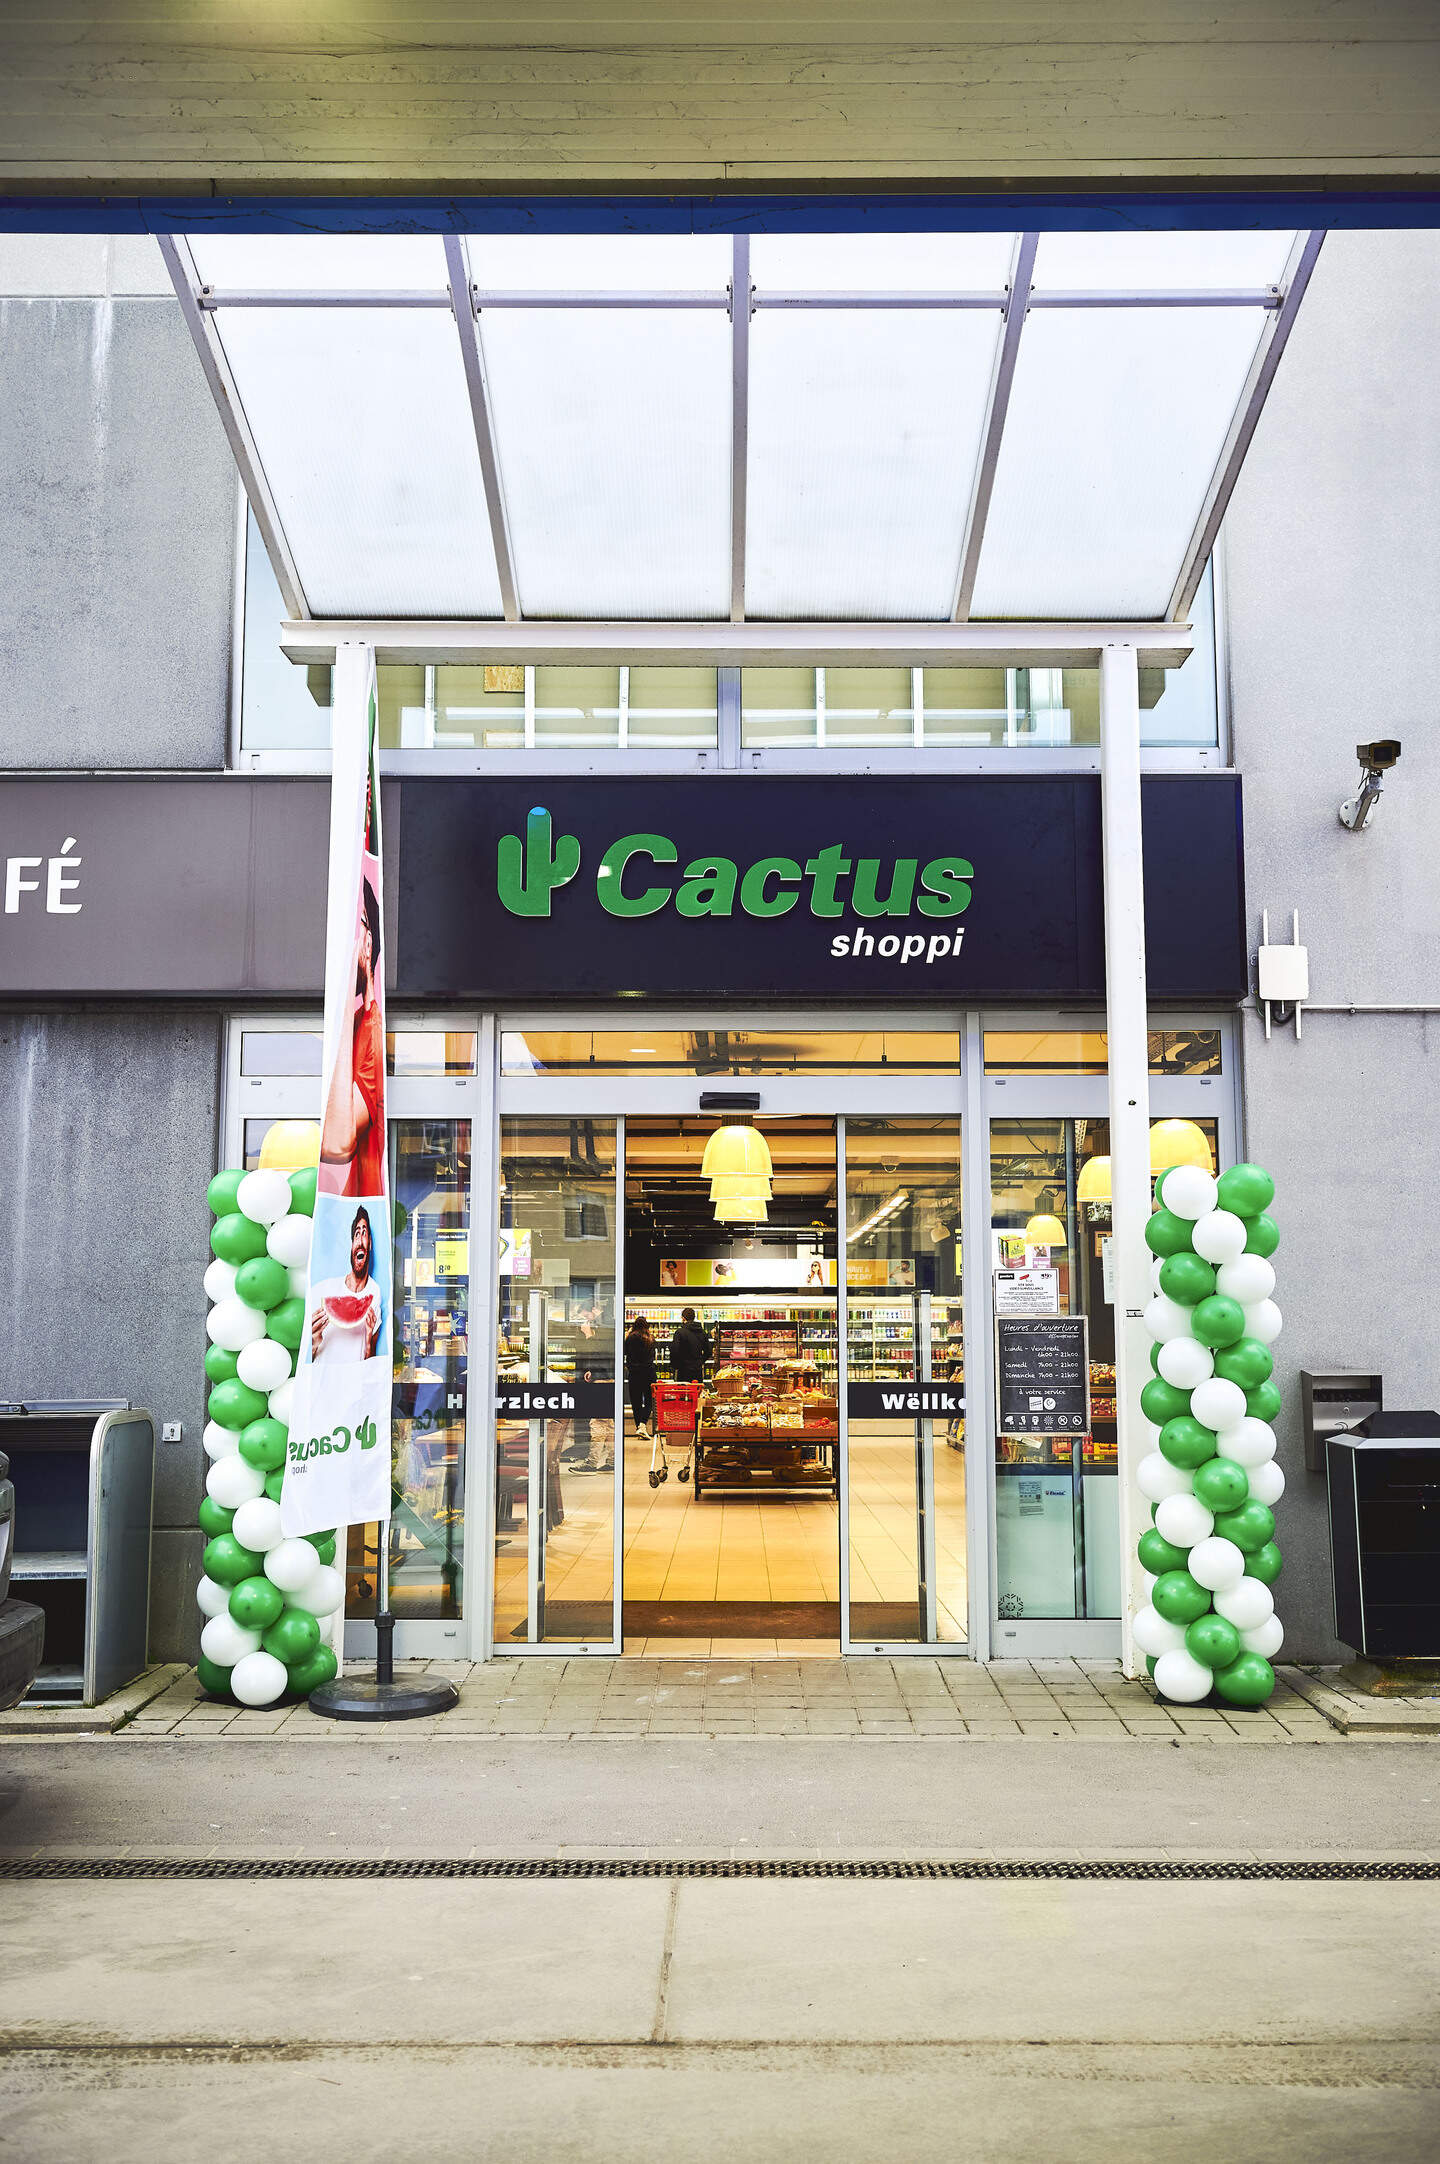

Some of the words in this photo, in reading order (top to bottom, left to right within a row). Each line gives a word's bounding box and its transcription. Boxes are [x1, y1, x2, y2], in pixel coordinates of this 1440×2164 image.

[4, 836, 83, 914] FÉ
[597, 833, 974, 917] Cactus
[830, 927, 964, 964] shoppi
[1004, 1323, 1030, 1332] Heures
[1034, 1323, 1079, 1332] d'ouverture
[447, 1392, 576, 1410] Hrzlech
